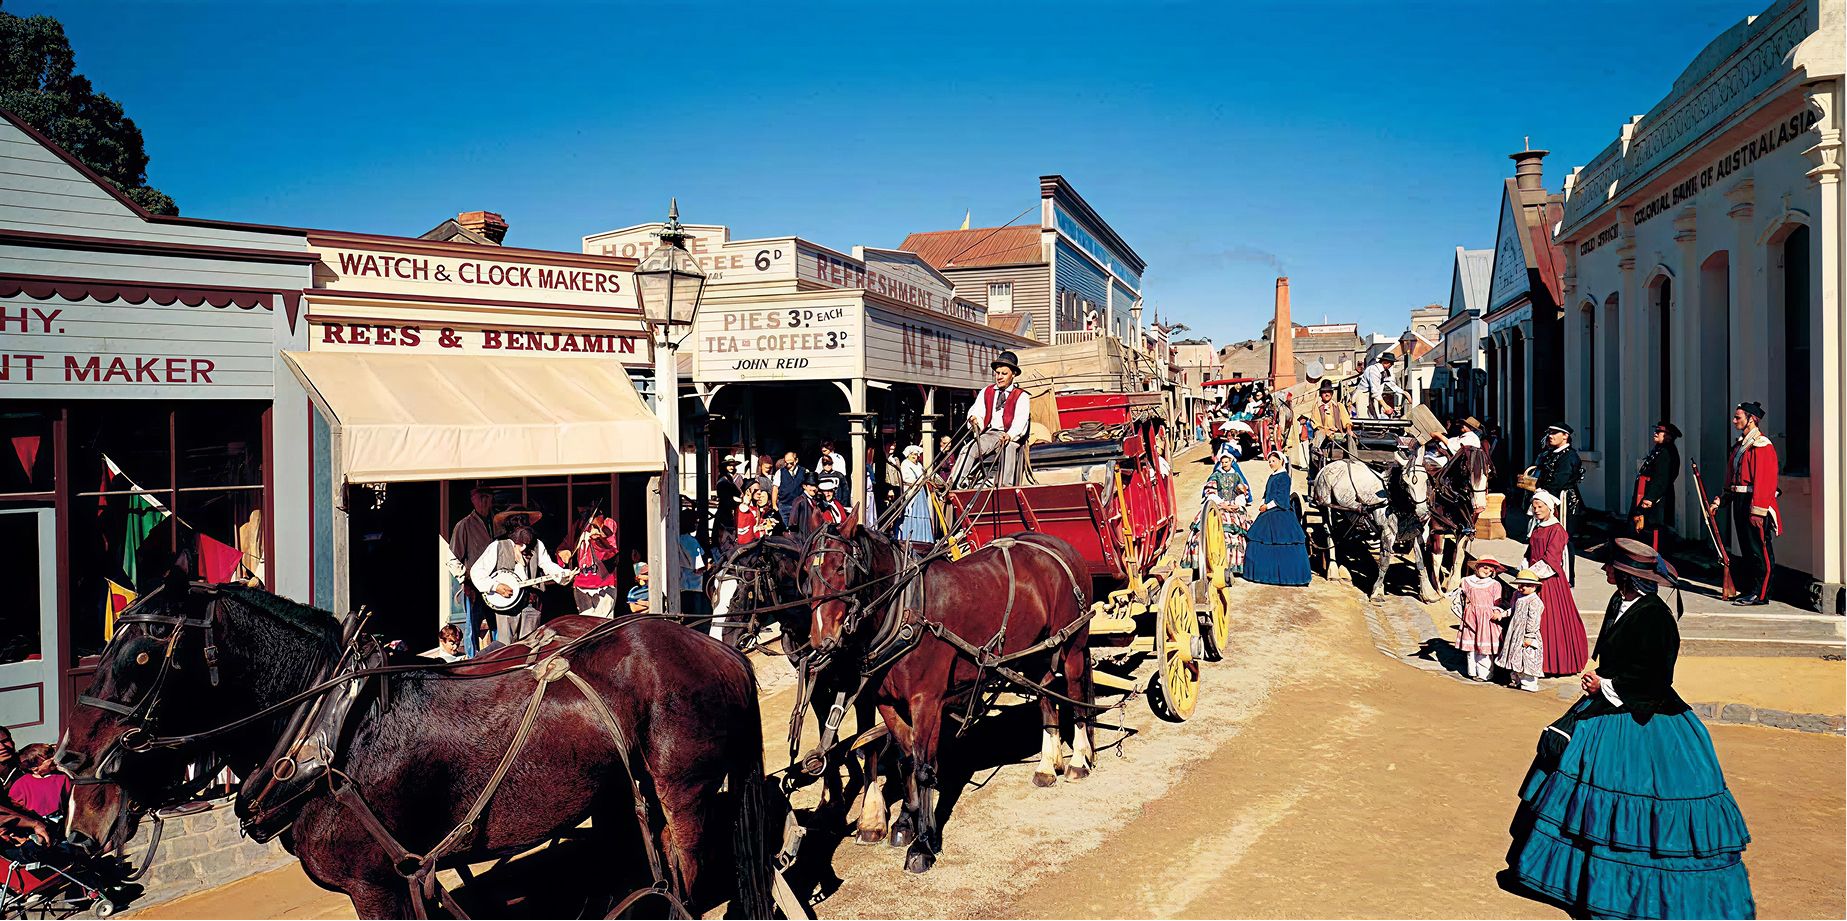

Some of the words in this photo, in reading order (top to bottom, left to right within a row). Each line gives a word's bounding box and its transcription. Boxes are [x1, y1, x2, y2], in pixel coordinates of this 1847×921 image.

[1701, 166, 1714, 188] OF
[602, 241, 654, 259] HOT
[338, 252, 430, 280] WATCH
[434, 264, 452, 282] &
[458, 262, 532, 288] CLOCK
[538, 269, 620, 293] MAKERS
[817, 253, 933, 310] REFRESHMENT
[723, 311, 780, 331] PIES
[817, 308, 843, 322] EACH
[322, 323, 421, 347] REES
[439, 327, 463, 348] &
[483, 330, 635, 354] BENJAMIN
[706, 334, 740, 353] TEA
[756, 332, 823, 351] COFFEE
[903, 323, 951, 372] NEW
[64, 355, 215, 383] MAKER
[732, 358, 769, 370] JOHN
[776, 358, 809, 369] REID
